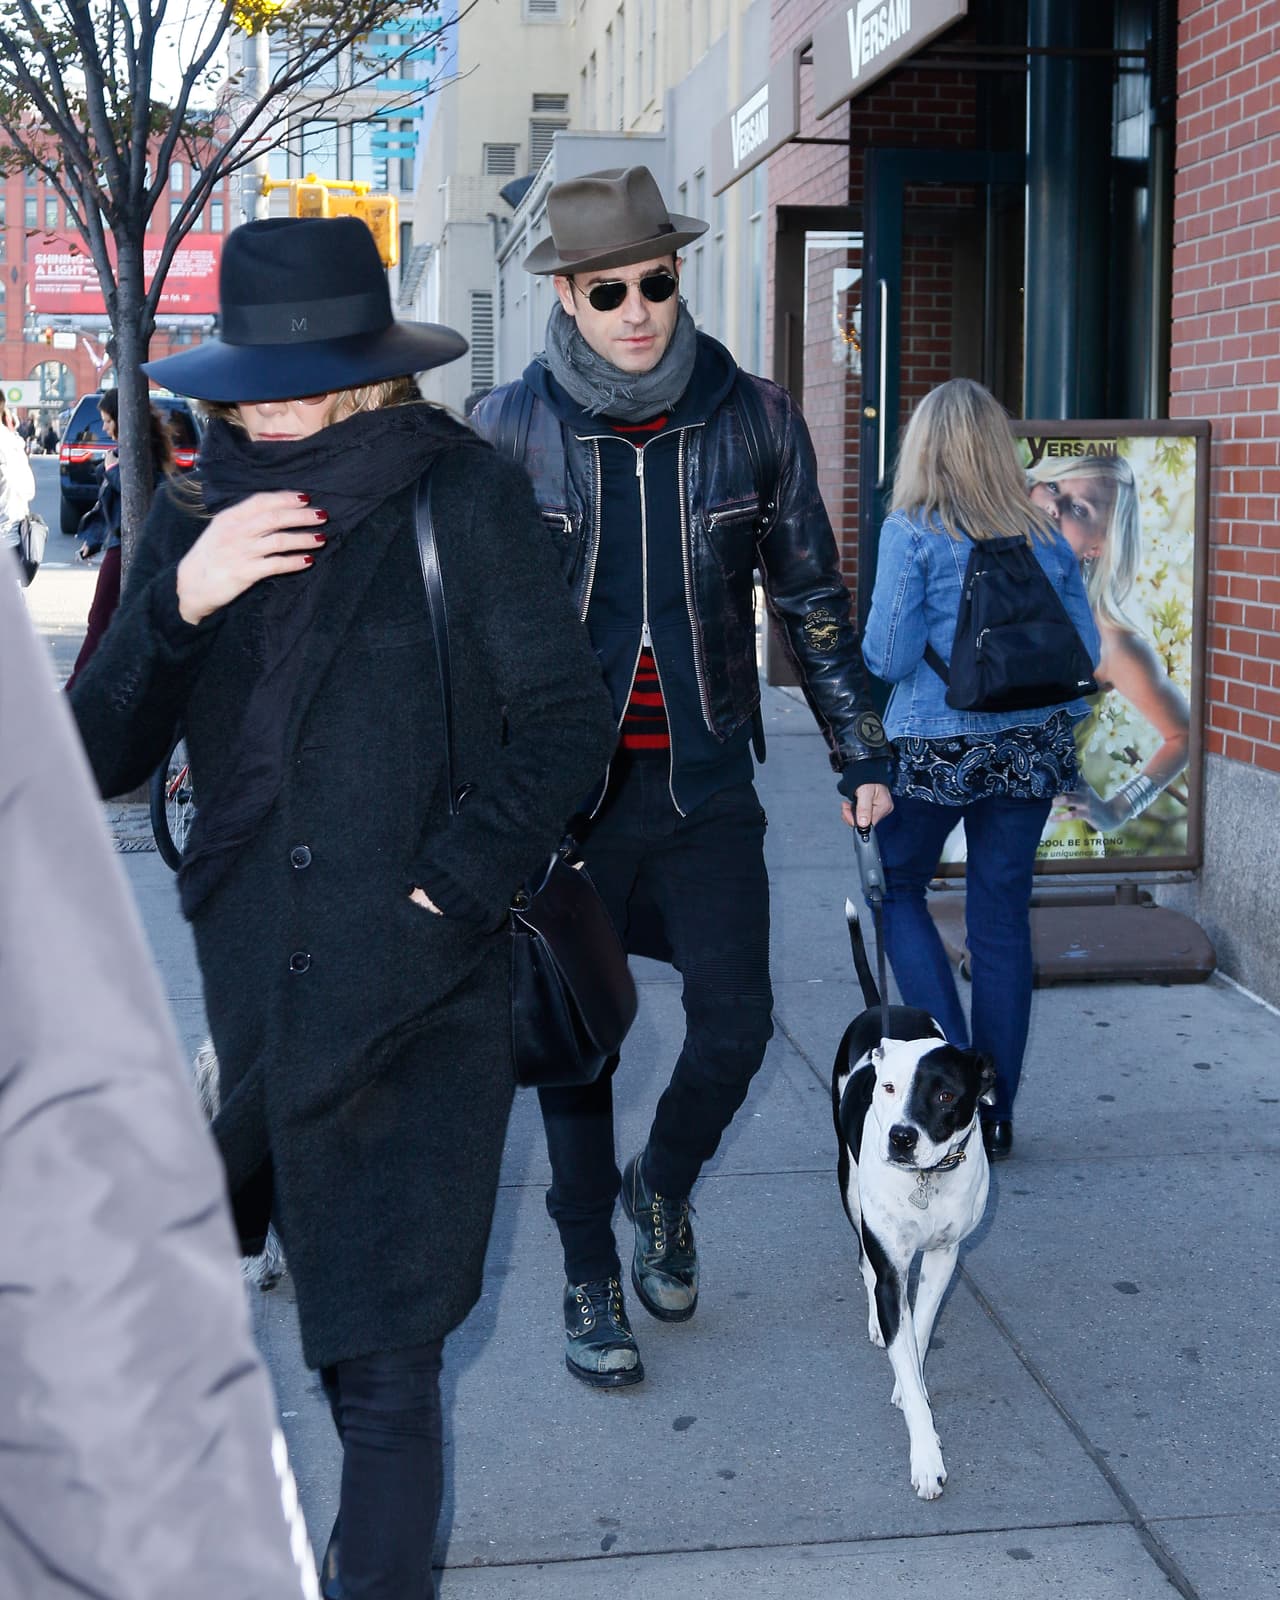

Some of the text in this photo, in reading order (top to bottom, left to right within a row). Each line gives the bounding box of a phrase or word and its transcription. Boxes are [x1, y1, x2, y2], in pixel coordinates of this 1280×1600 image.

[34, 254, 84, 265] SHINING
[34, 264, 46, 275] A
[47, 264, 84, 275] LIGHT
[290, 318, 308, 332] M
[1067, 838, 1081, 847] BE
[1083, 837, 1123, 846] STRONG
